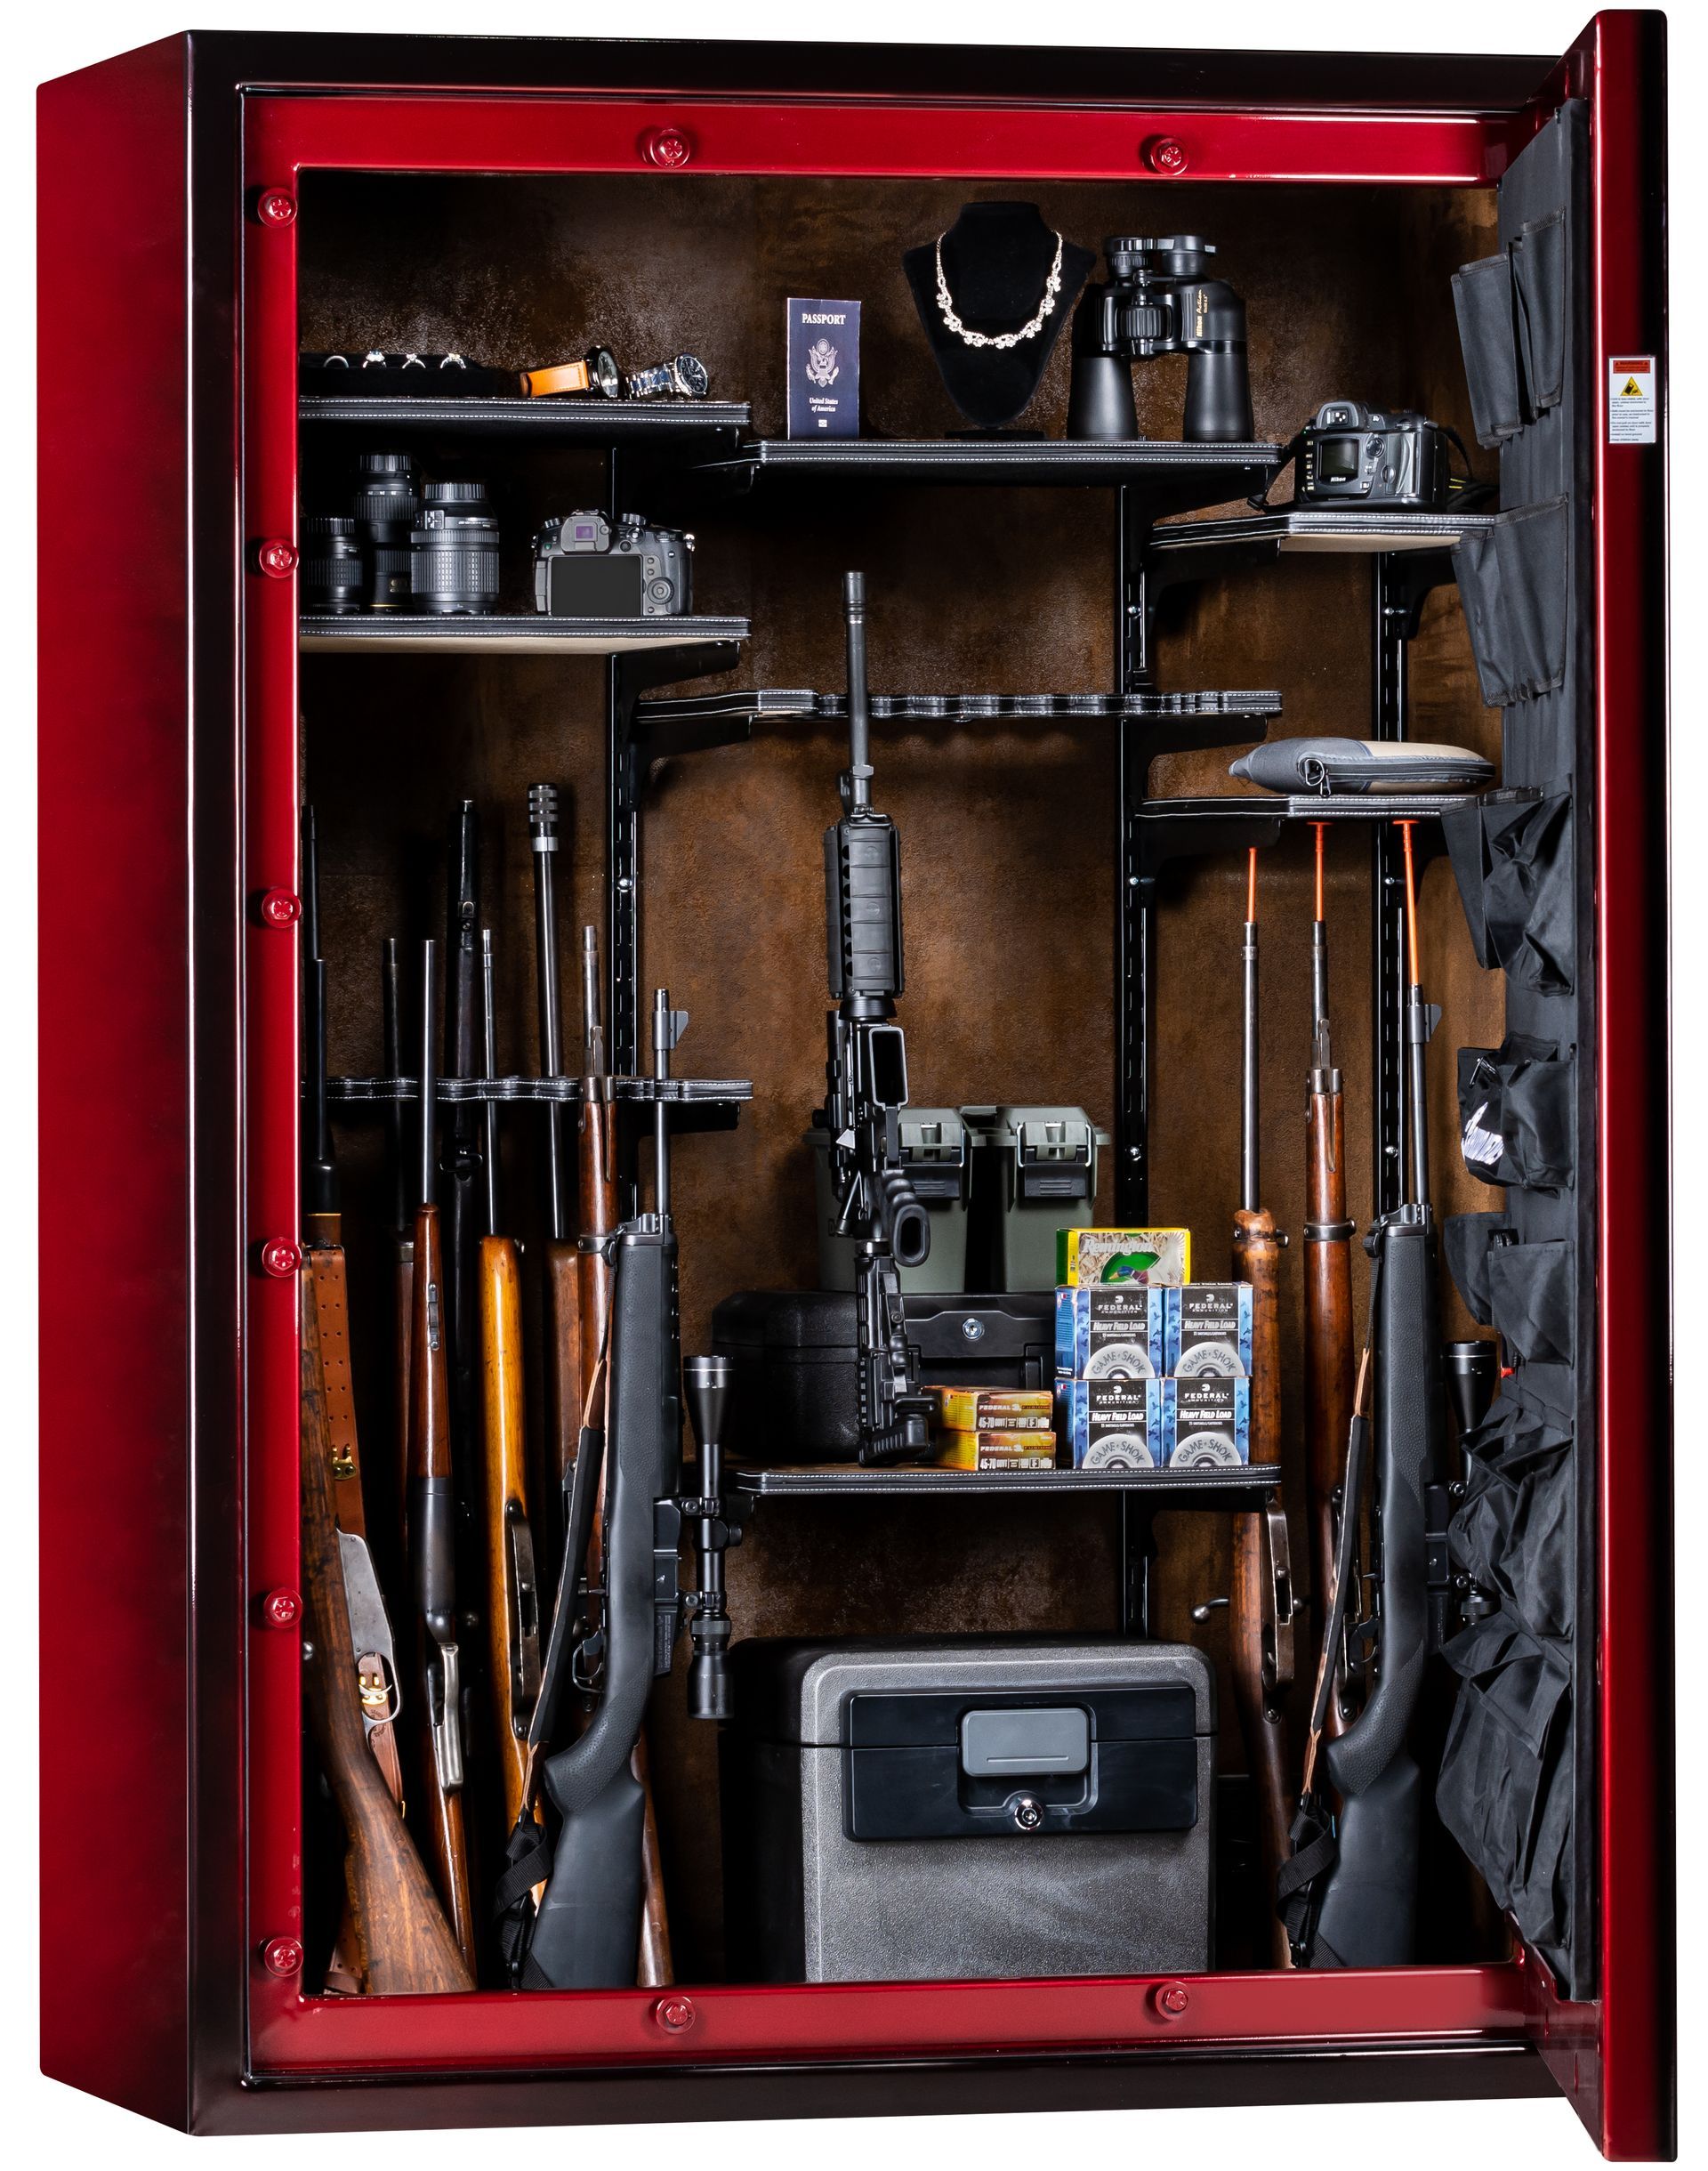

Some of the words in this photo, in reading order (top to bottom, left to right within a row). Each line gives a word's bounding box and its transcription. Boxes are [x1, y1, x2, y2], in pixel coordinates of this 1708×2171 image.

[802, 313, 846, 325] PASSPORT
[809, 397, 824, 405] United
[811, 405, 817, 413] of
[1083, 1239, 1154, 1255] Remington
[1093, 1322, 1113, 1331] HEAVY
[1129, 1322, 1146, 1330] LOAD
[1184, 1320, 1204, 1329] HEAVY
[1220, 1320, 1236, 1328] LOAD
[1092, 1412, 1112, 1421] HEAVY
[1128, 1412, 1144, 1420] LOAD
[1180, 1410, 1200, 1419] HEAVY
[1215, 1410, 1232, 1418] LOAD
